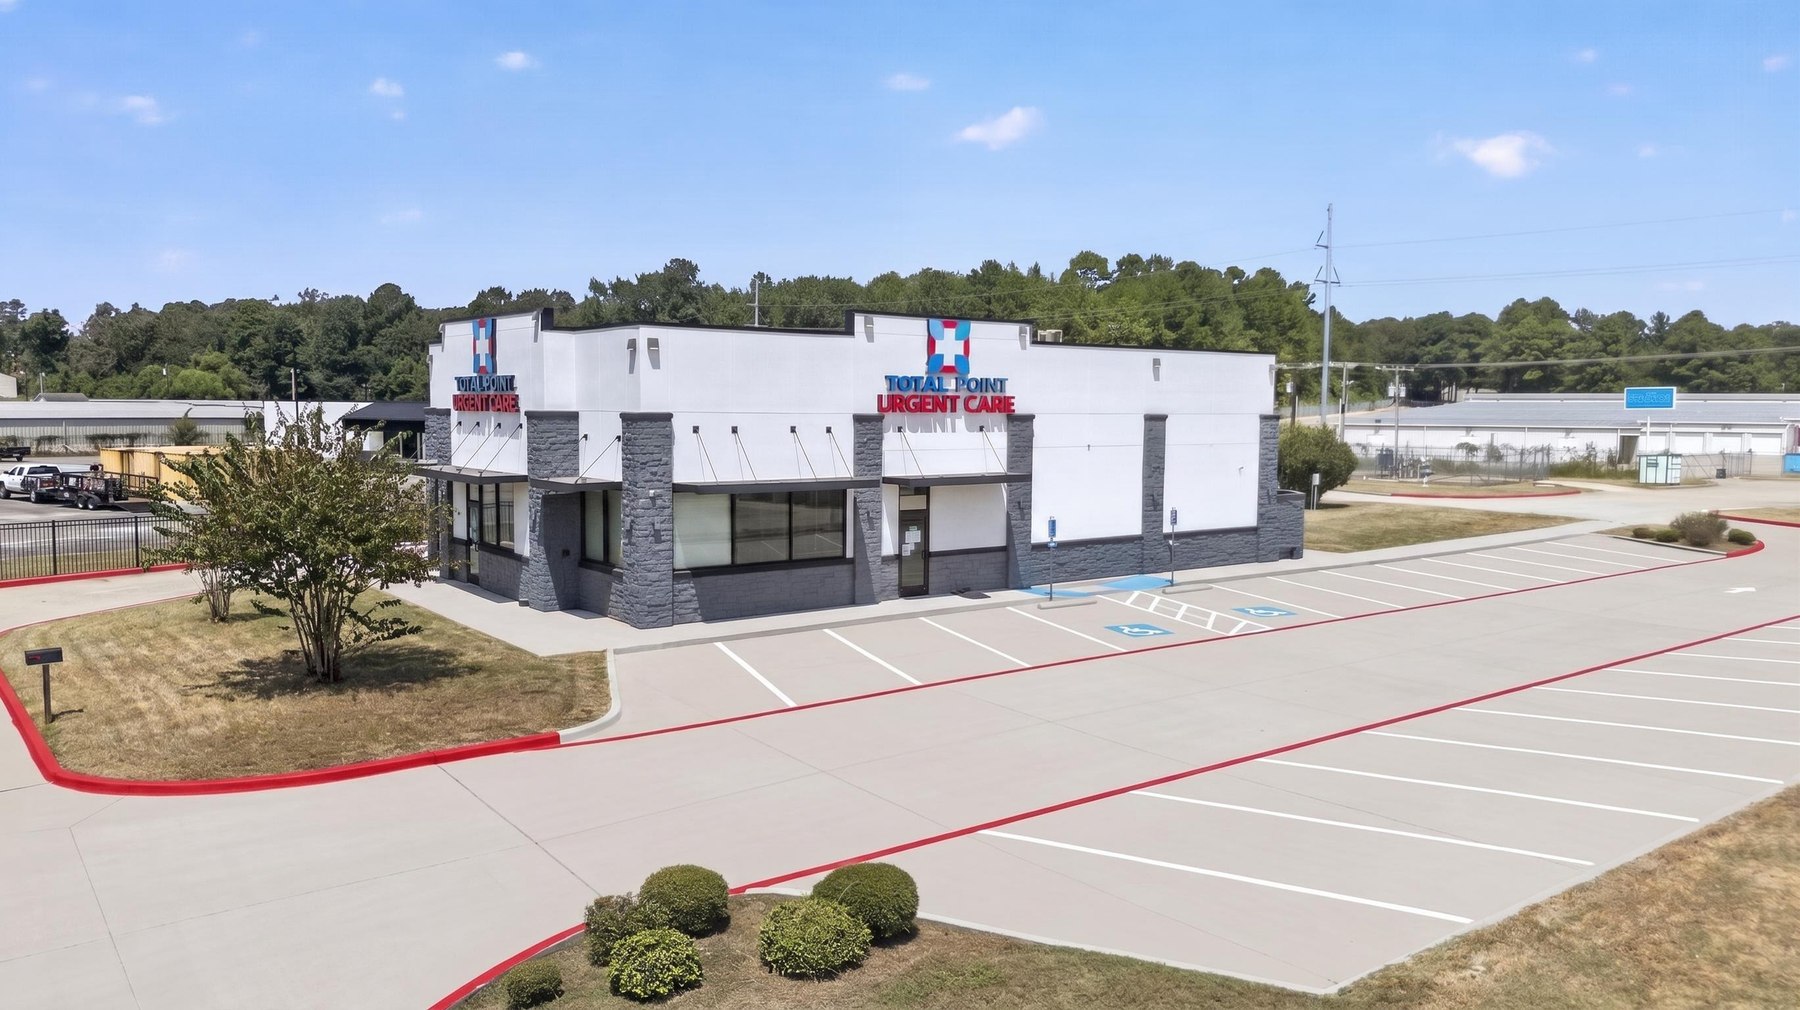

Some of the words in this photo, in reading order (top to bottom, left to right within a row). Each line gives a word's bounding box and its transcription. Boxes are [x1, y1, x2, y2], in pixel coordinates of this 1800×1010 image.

[454, 376, 482, 391] TOTAL
[483, 375, 515, 391] POINT
[885, 375, 949, 392] TOTAL
[955, 377, 1008, 393] POINT
[452, 394, 488, 411] URGENT
[490, 394, 519, 412] CARE
[877, 394, 960, 413] URGENT
[964, 395, 1015, 413] CARE
